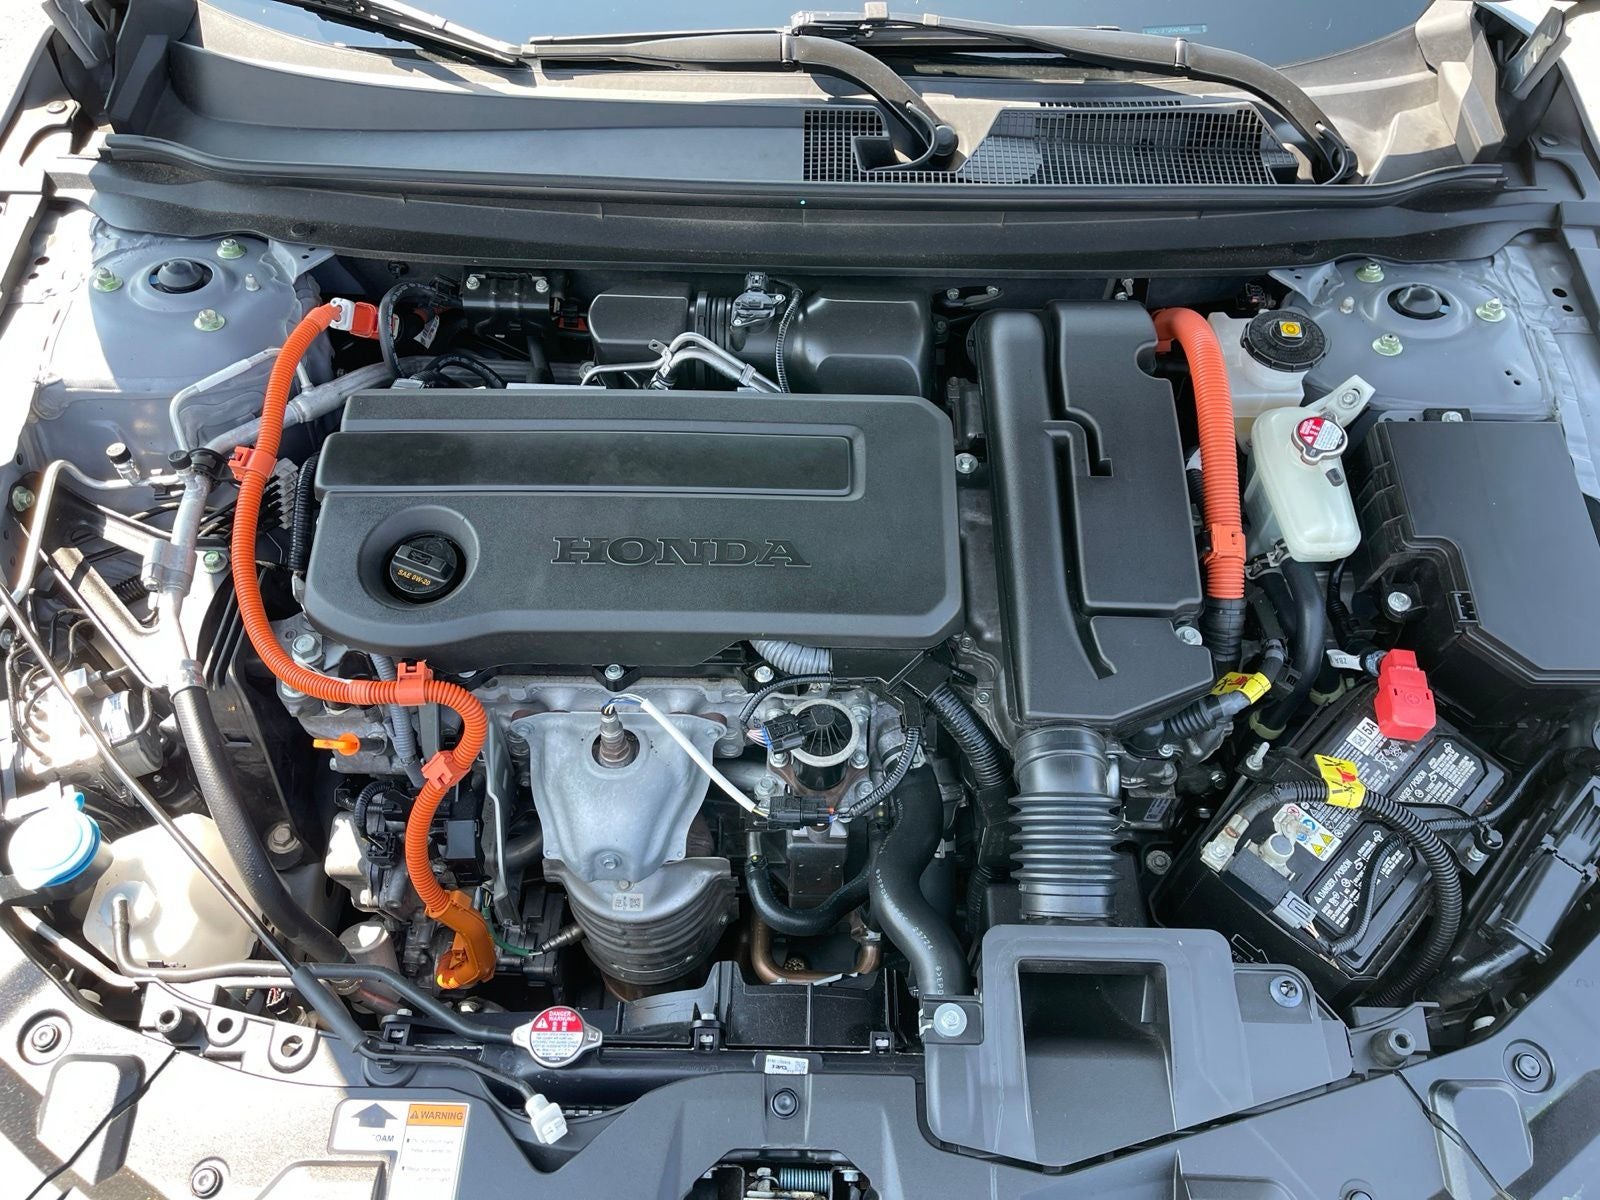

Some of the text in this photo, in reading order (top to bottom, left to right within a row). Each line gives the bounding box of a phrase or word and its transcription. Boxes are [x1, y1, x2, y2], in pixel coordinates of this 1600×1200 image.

[550, 535, 812, 568] HONDA
[397, 569, 412, 580] SAE
[1361, 721, 1378, 736] 5A
[420, 1111, 464, 1120] WARNING
